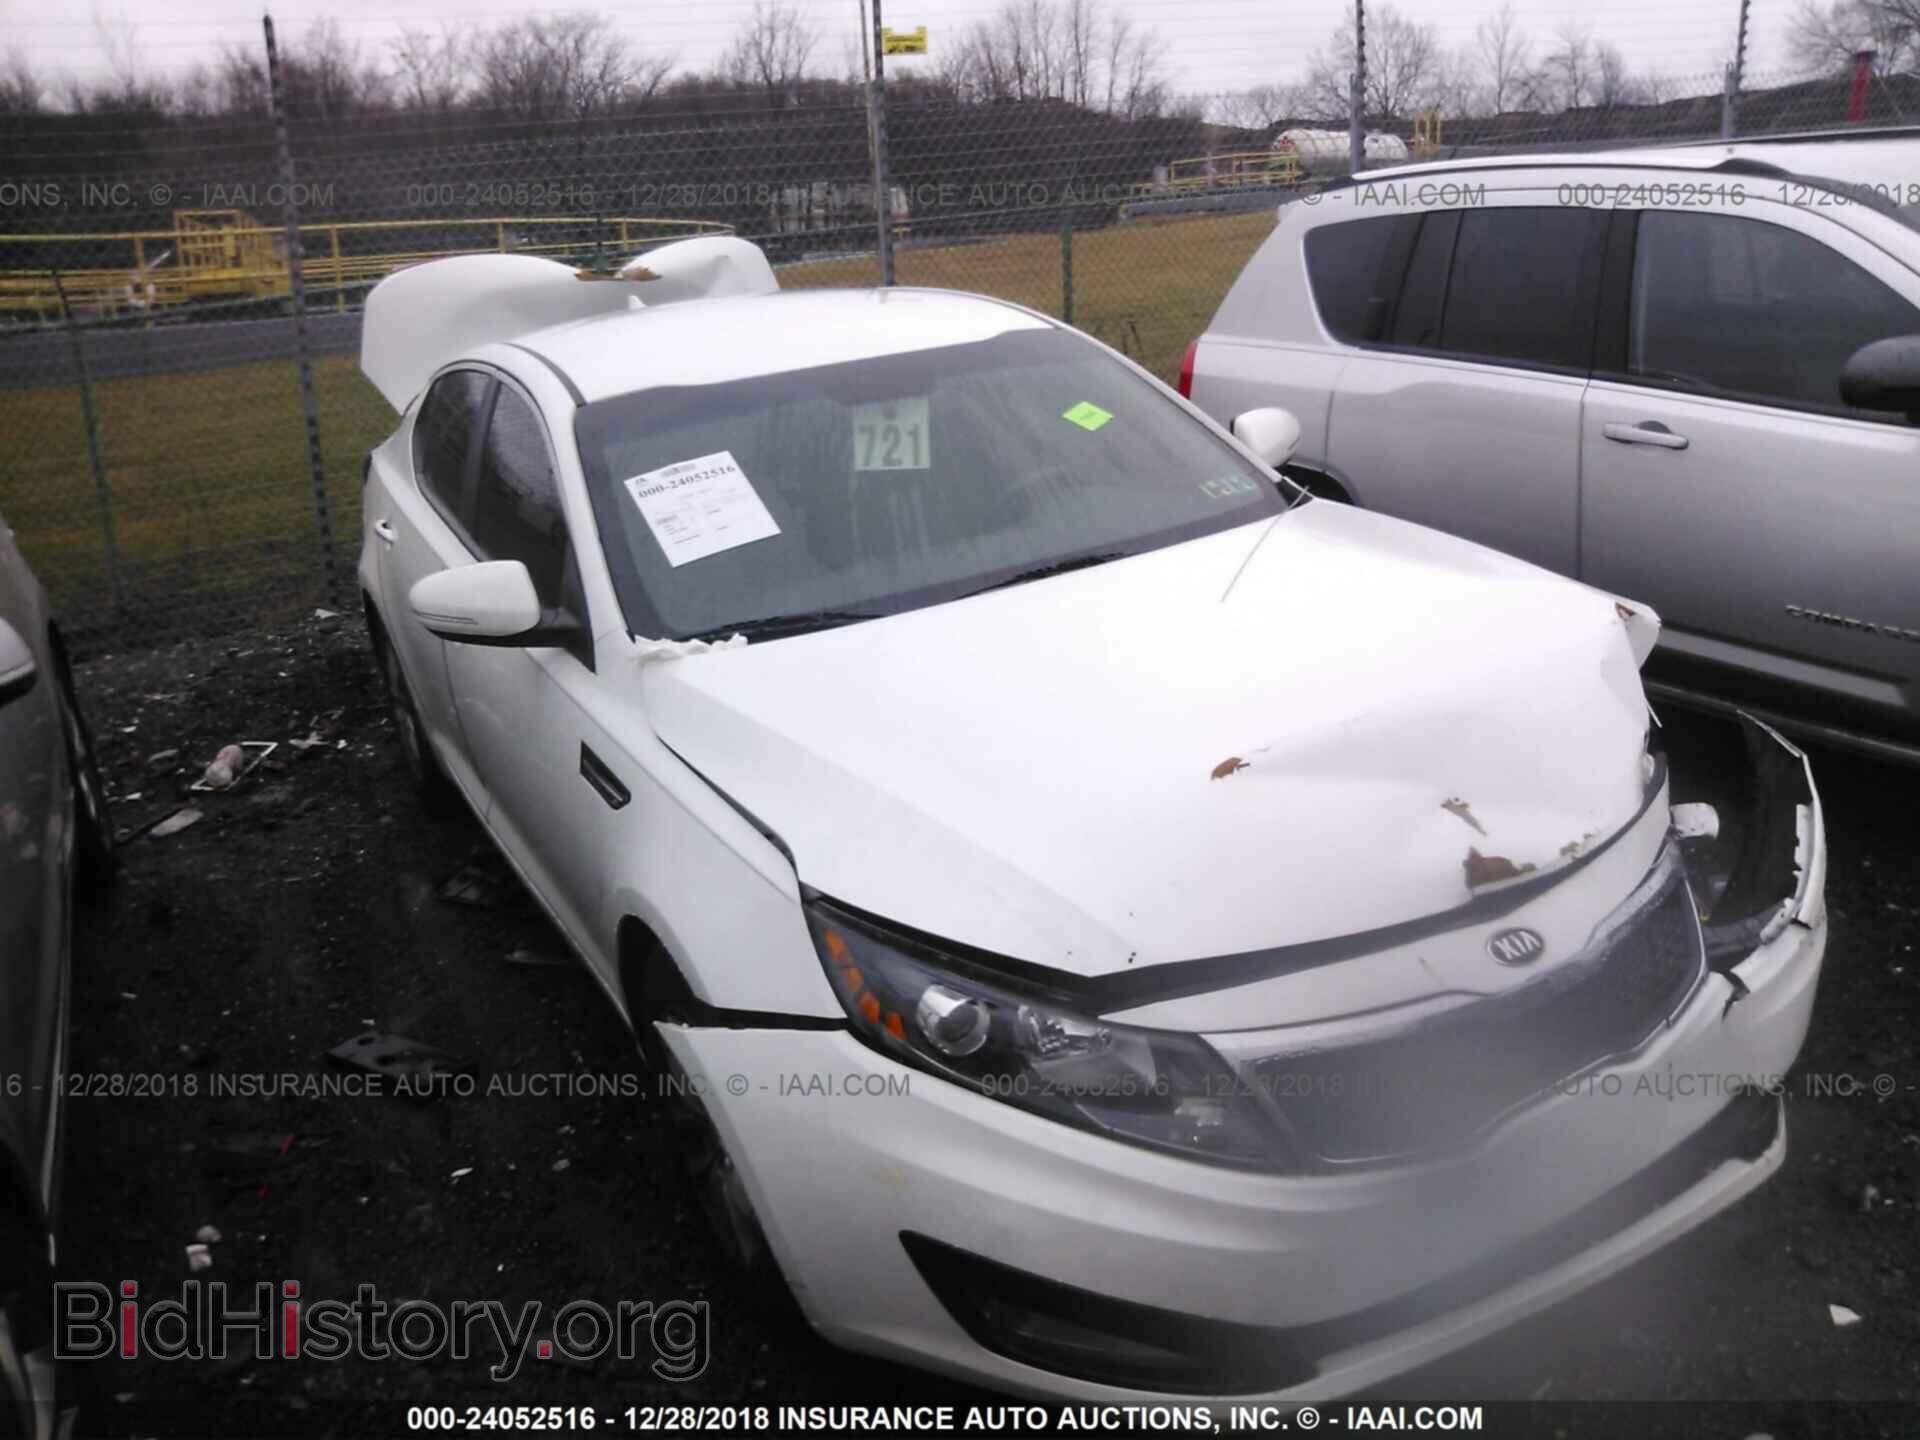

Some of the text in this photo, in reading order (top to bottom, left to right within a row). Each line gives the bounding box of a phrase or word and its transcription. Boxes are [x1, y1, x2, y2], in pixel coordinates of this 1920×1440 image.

[857, 421, 920, 467] 721
[637, 463, 737, 499] 000-24052516
[1494, 930, 1542, 961] KIA
